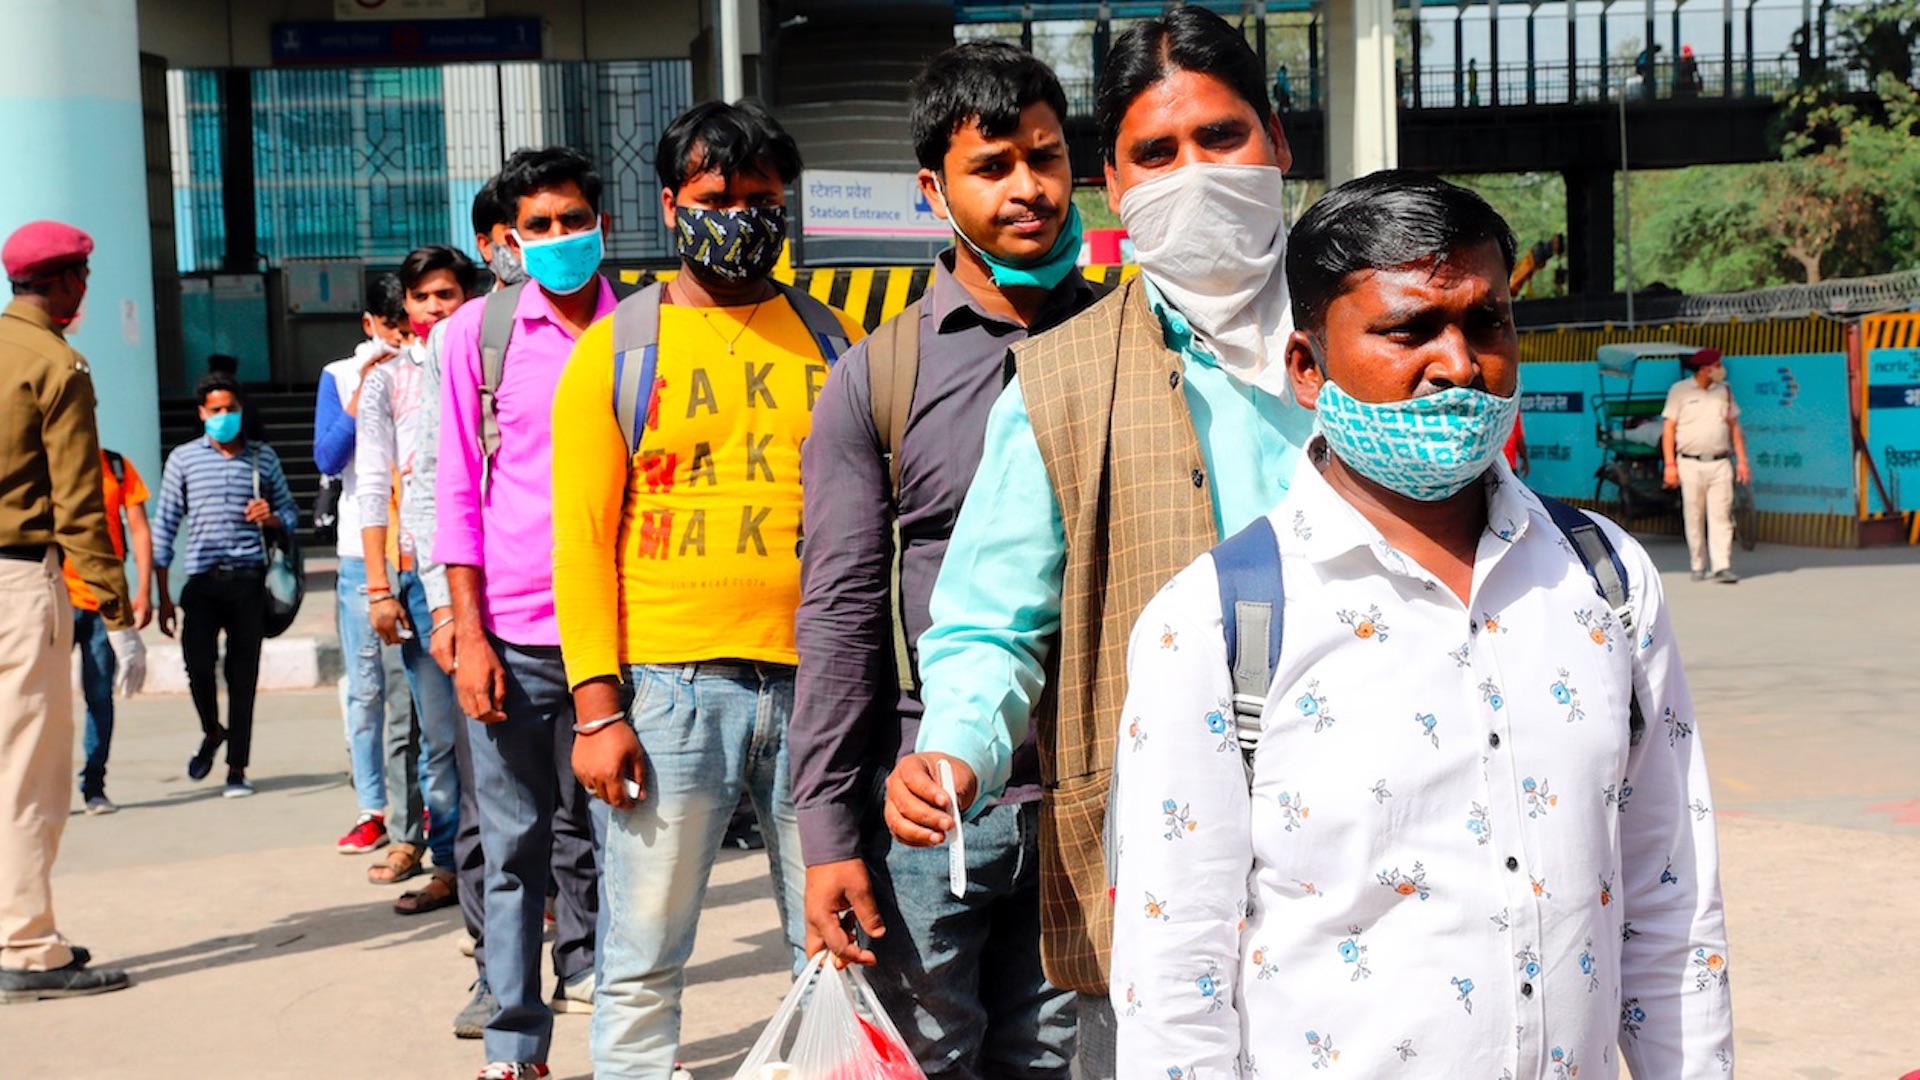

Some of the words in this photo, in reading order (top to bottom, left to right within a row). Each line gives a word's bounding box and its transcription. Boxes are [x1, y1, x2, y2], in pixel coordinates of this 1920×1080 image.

[810, 181, 841, 198] स्टेशन
[845, 182, 872, 198] प्रवेश
[810, 206, 849, 218] Station
[853, 207, 900, 220] Entrance
[636, 432, 803, 493] WAK
[638, 505, 804, 560] MAK
